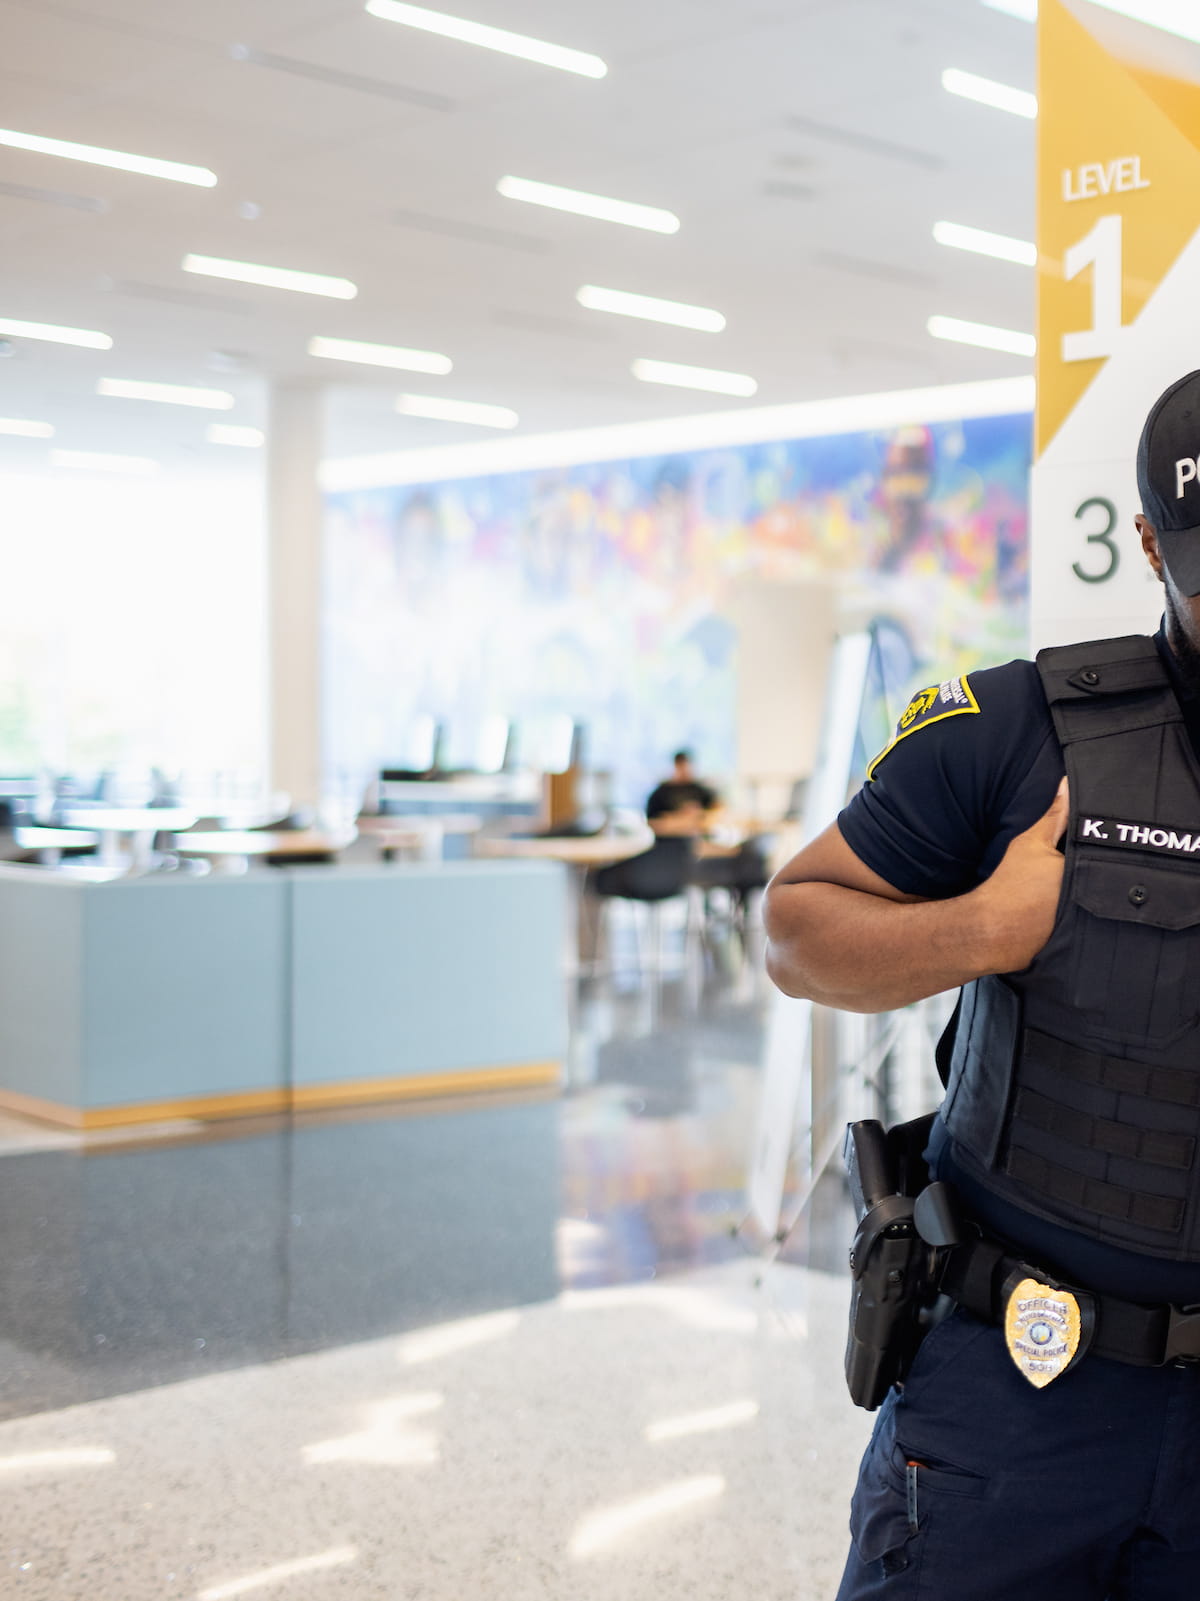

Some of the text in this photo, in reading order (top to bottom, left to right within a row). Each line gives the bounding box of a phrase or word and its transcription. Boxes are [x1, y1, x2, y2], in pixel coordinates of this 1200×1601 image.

[1062, 155, 1151, 202] LEVEL
[1061, 214, 1133, 363] 1
[1071, 497, 1121, 584] 3
[1082, 818, 1109, 839] K.
